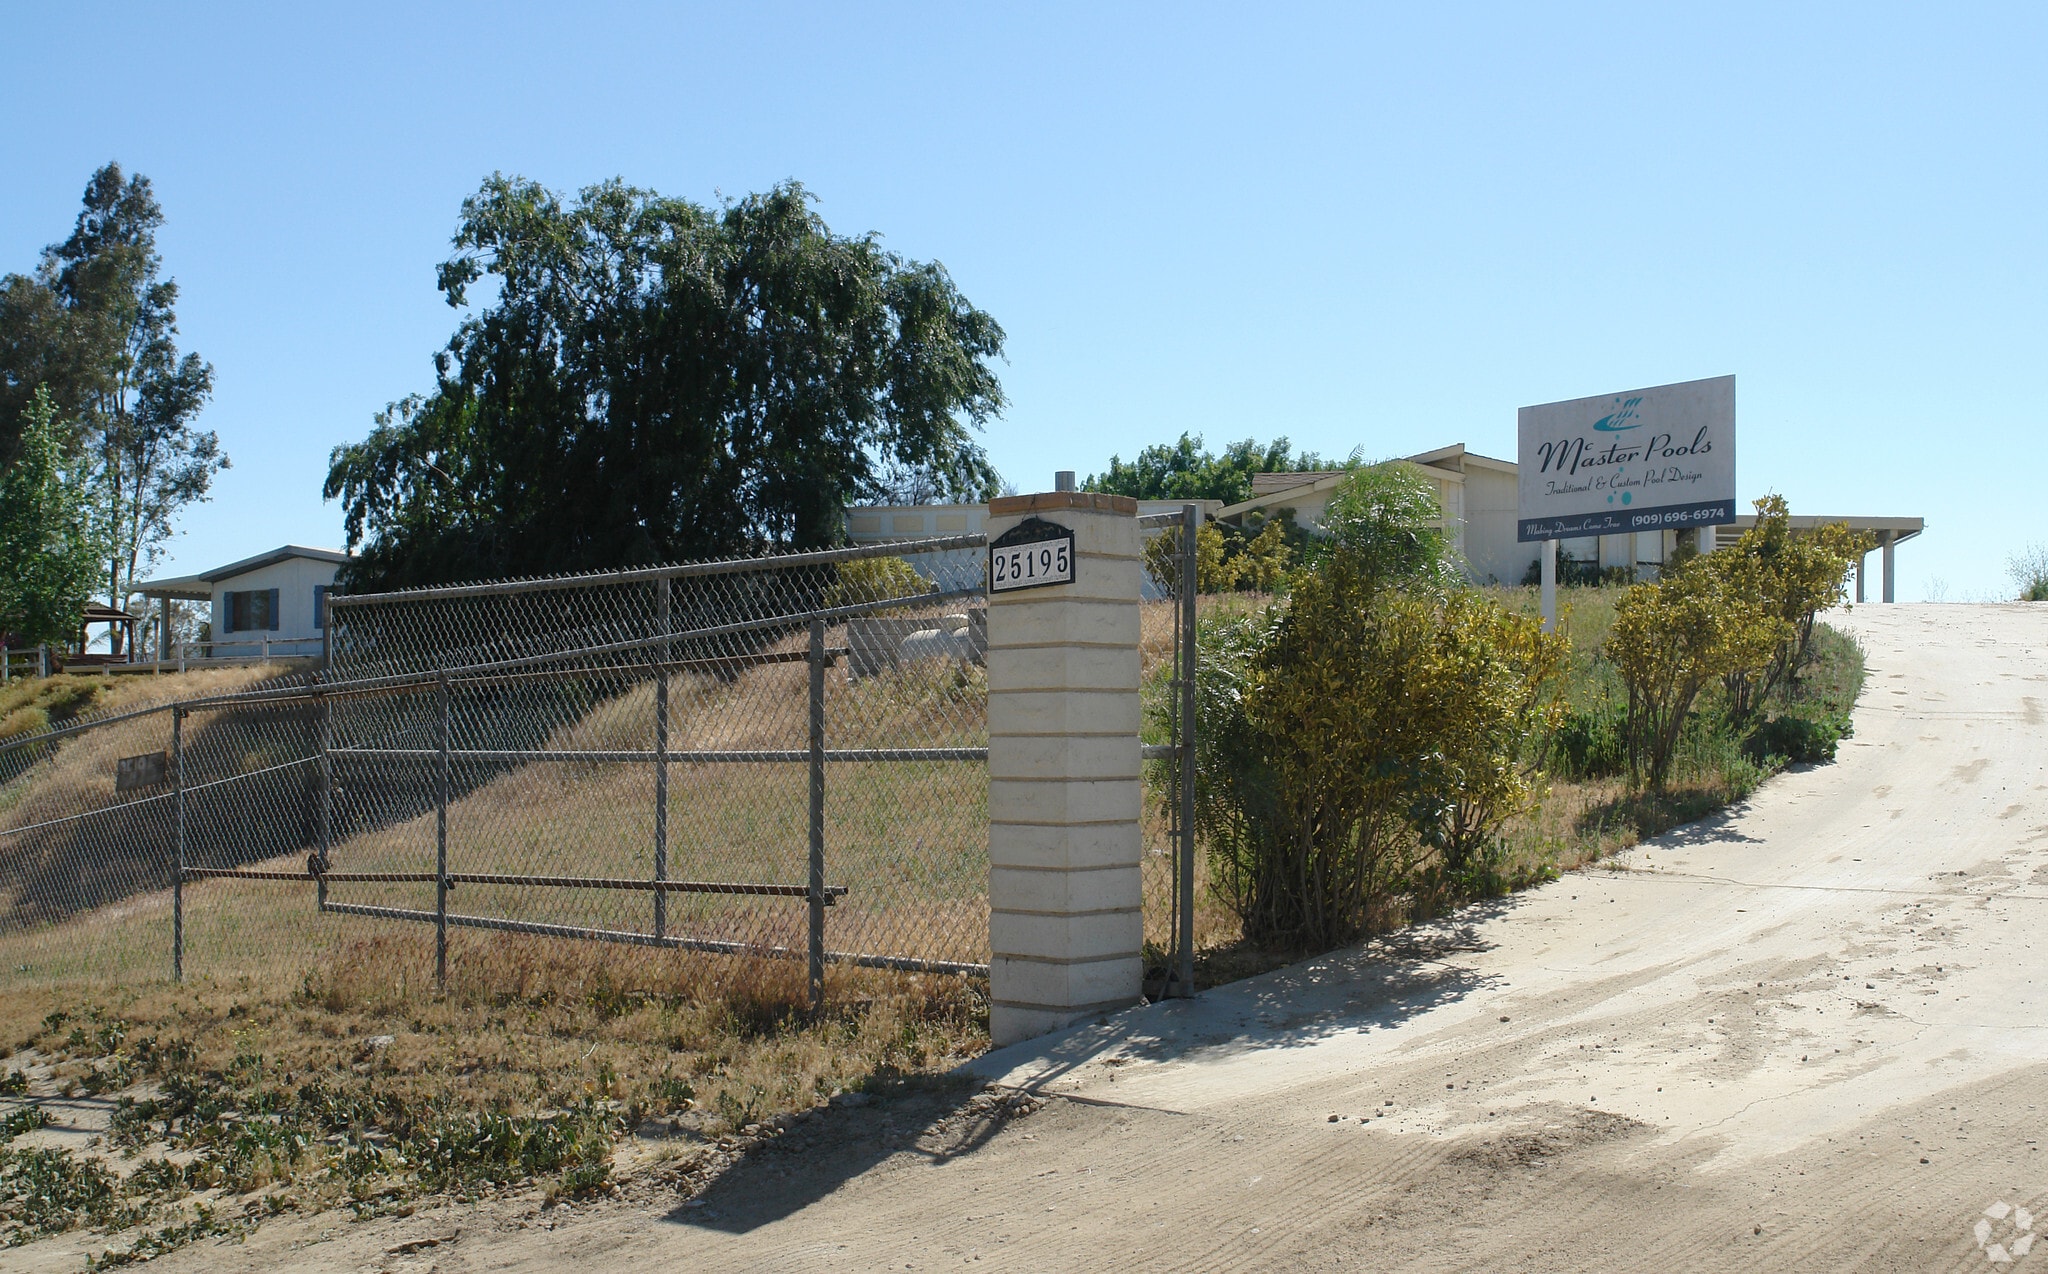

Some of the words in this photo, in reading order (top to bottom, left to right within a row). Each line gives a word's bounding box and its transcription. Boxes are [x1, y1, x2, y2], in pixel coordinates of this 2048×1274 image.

[1644, 425, 1713, 461] Pools
[1545, 477, 1592, 496] Traditional
[1595, 478, 1607, 489] &
[1610, 473, 1641, 488] Custom
[1643, 468, 1666, 488] Pool
[1668, 466, 1703, 484] Design
[1526, 523, 1553, 536] Making
[1555, 521, 1582, 533] Dreams
[1583, 519, 1602, 530] Come
[1631, 513, 1662, 527] (909)
[1664, 508, 1725, 523] 696-6974
[995, 545, 1068, 582] 25195
